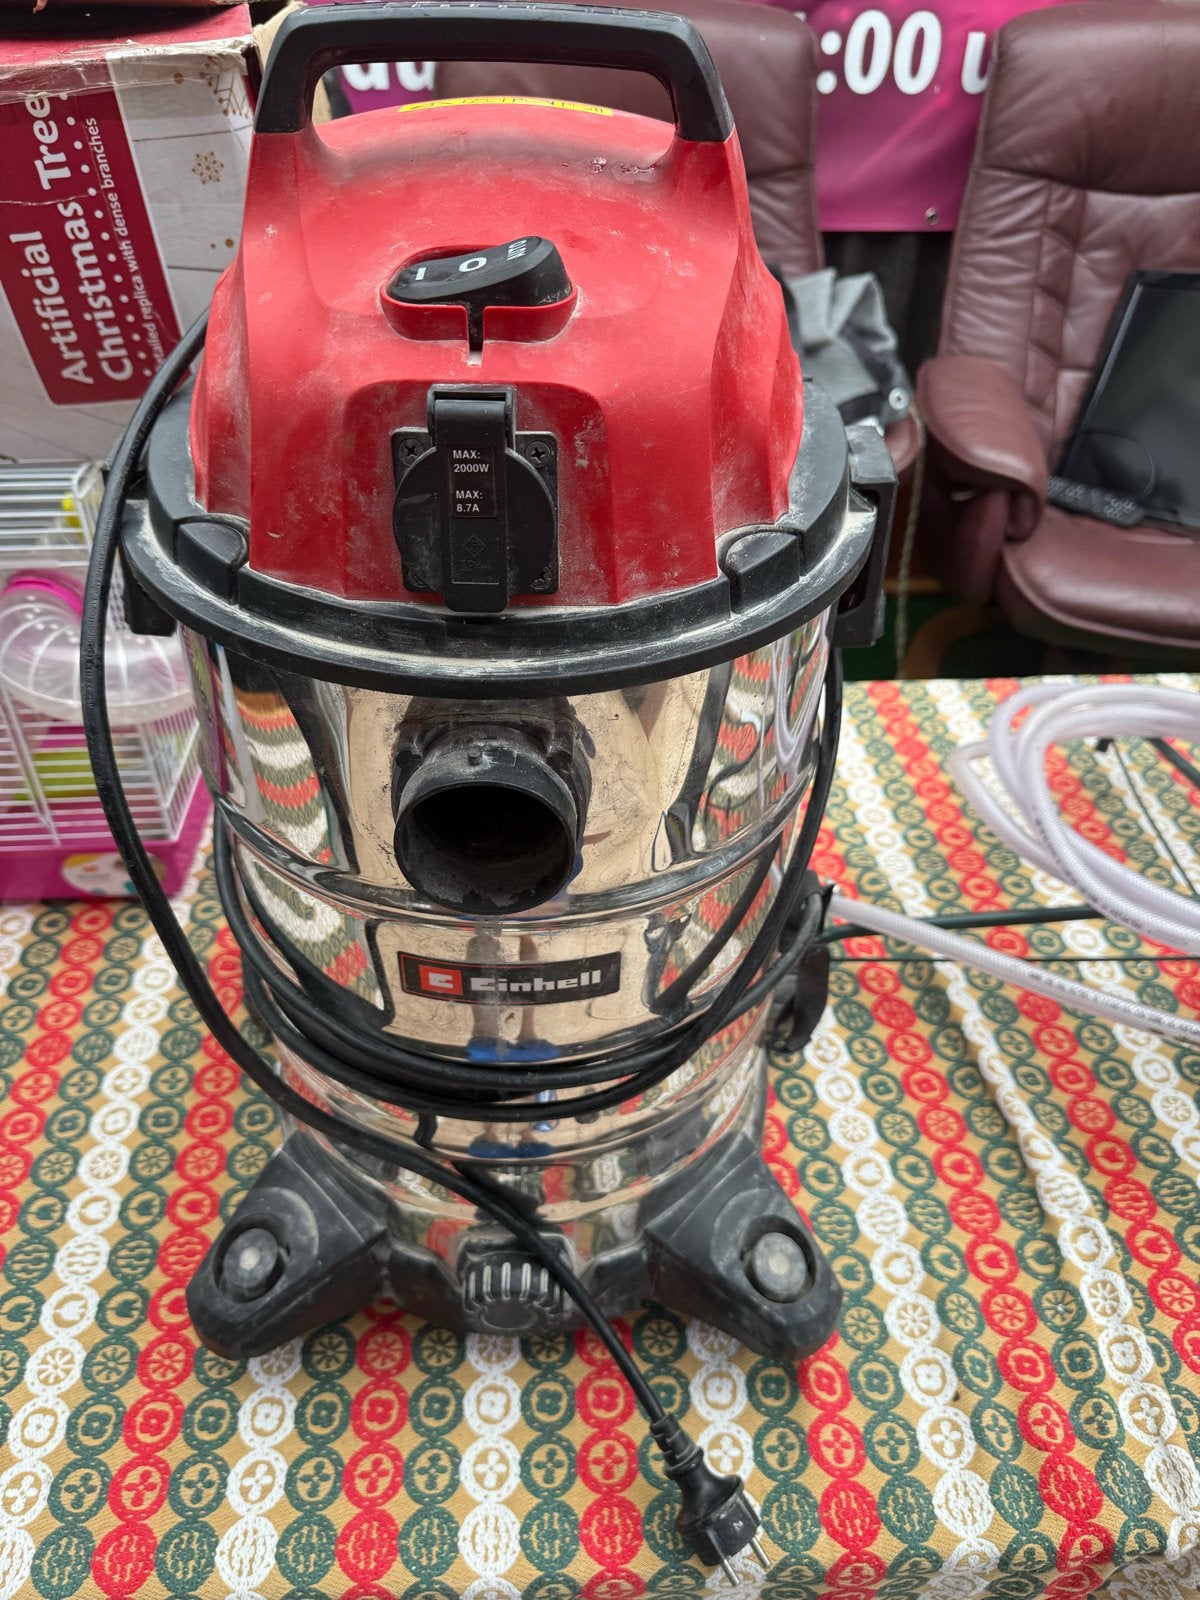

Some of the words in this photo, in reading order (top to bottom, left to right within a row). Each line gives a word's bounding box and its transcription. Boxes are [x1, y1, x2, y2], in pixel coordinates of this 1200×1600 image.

[795, 9, 942, 95] :00
[25, 94, 72, 190] Tree
[86, 117, 115, 189] branches
[107, 192, 129, 237] dense
[119, 240, 139, 272] with
[9, 231, 94, 384] Artificial
[57, 201, 134, 381] Christmas
[131, 275, 153, 320] replica
[453, 450, 481, 459] MAX:
[454, 464, 489, 473] 2000W
[455, 490, 483, 499] MAX:
[456, 503, 480, 512] 8.7A
[470, 969, 602, 991] Einhell
